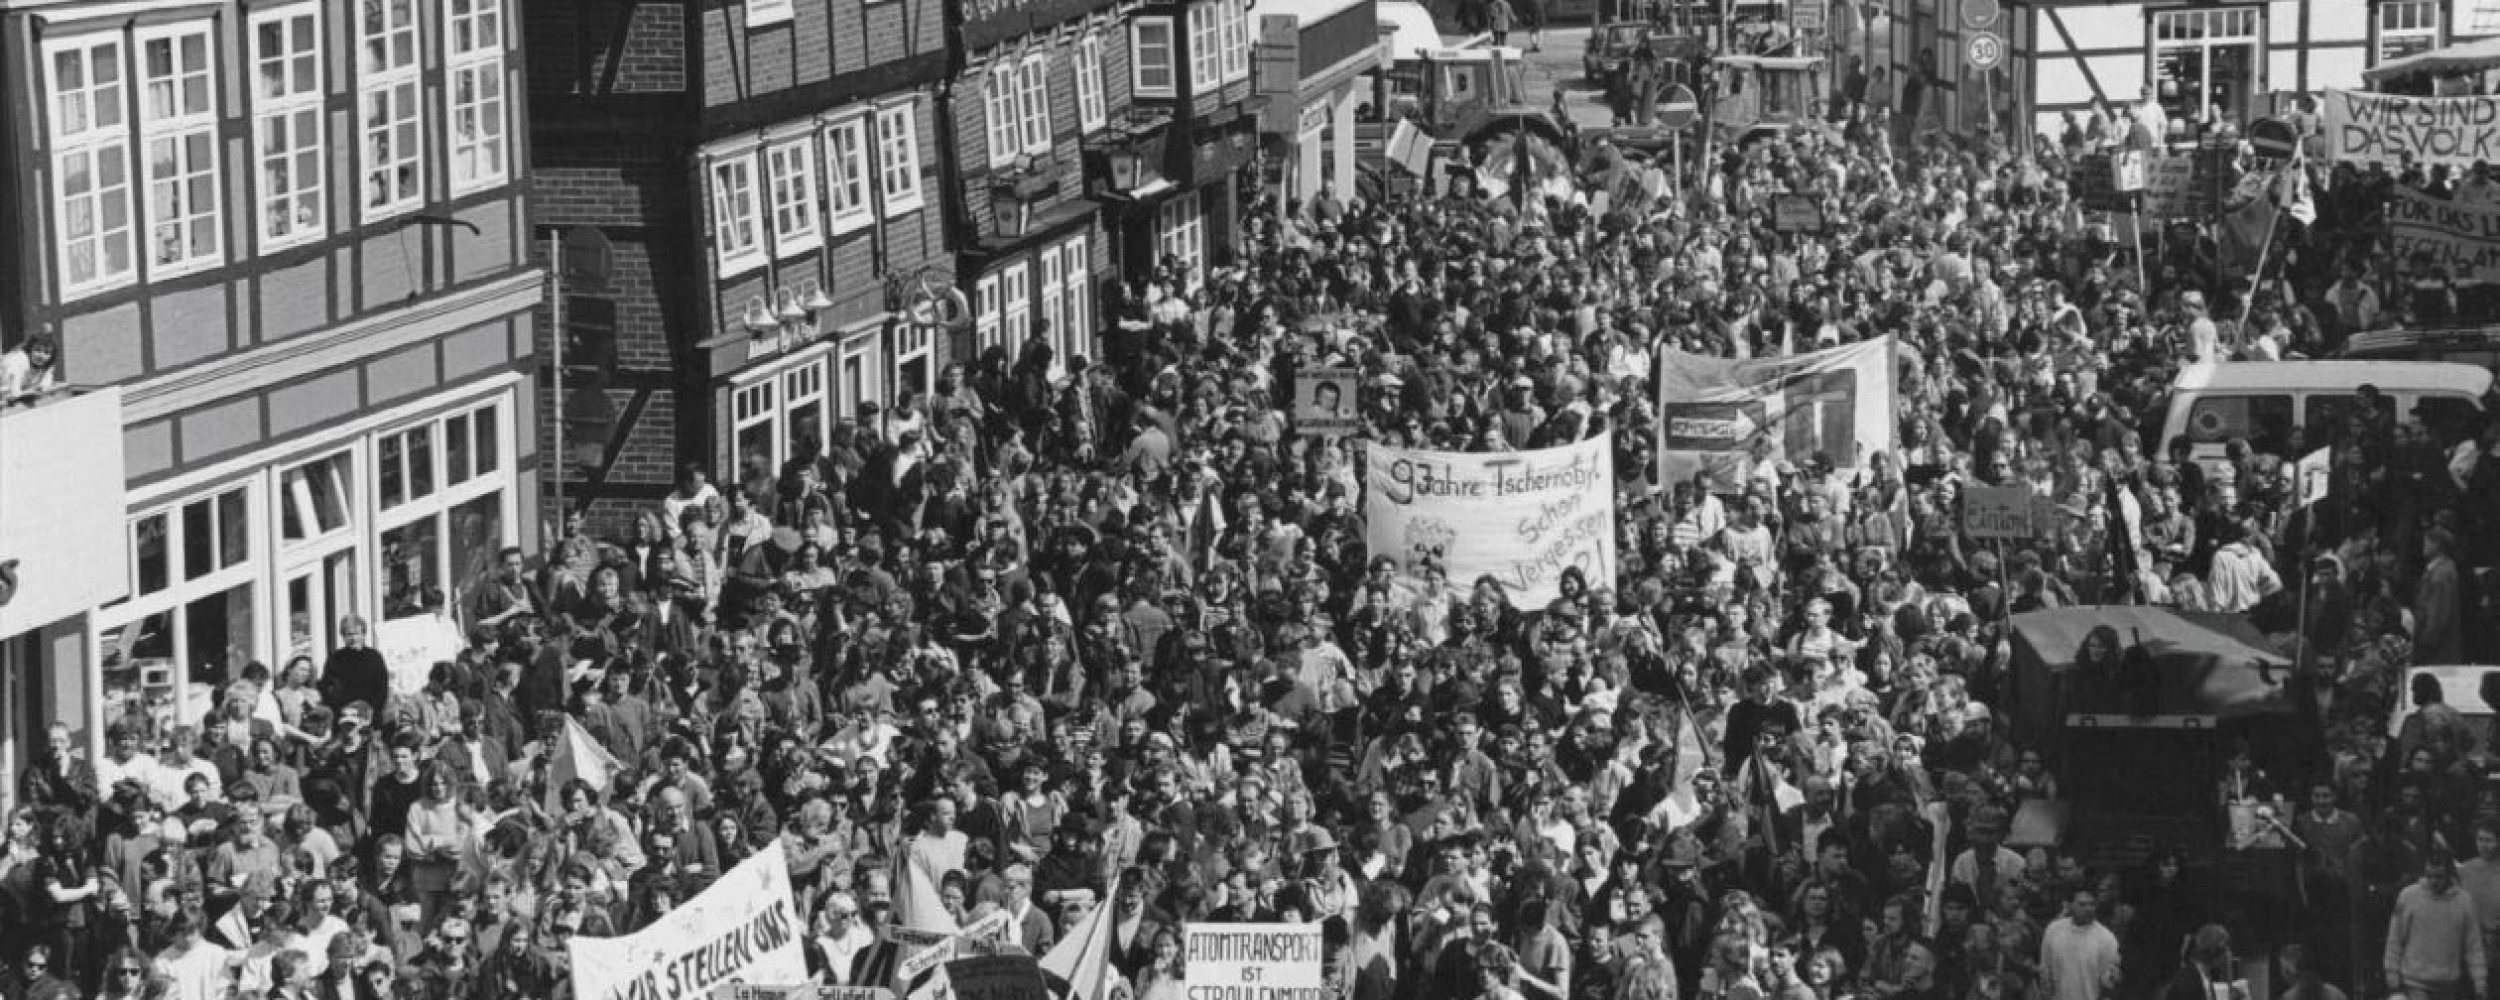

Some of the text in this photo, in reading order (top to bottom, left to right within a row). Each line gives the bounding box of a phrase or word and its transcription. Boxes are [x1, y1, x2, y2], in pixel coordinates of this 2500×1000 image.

[1974, 42, 1994, 60] 30
[2346, 93, 2496, 126] WIR SIND
[2343, 124, 2497, 159] DAS VOLK
[1384, 457, 1414, 505] 9
[666, 922, 754, 999] STELLEN
[754, 898, 791, 953] UNS
[1187, 931, 1321, 962] ATOMTRANSPORT
[1241, 965, 1264, 982] IST
